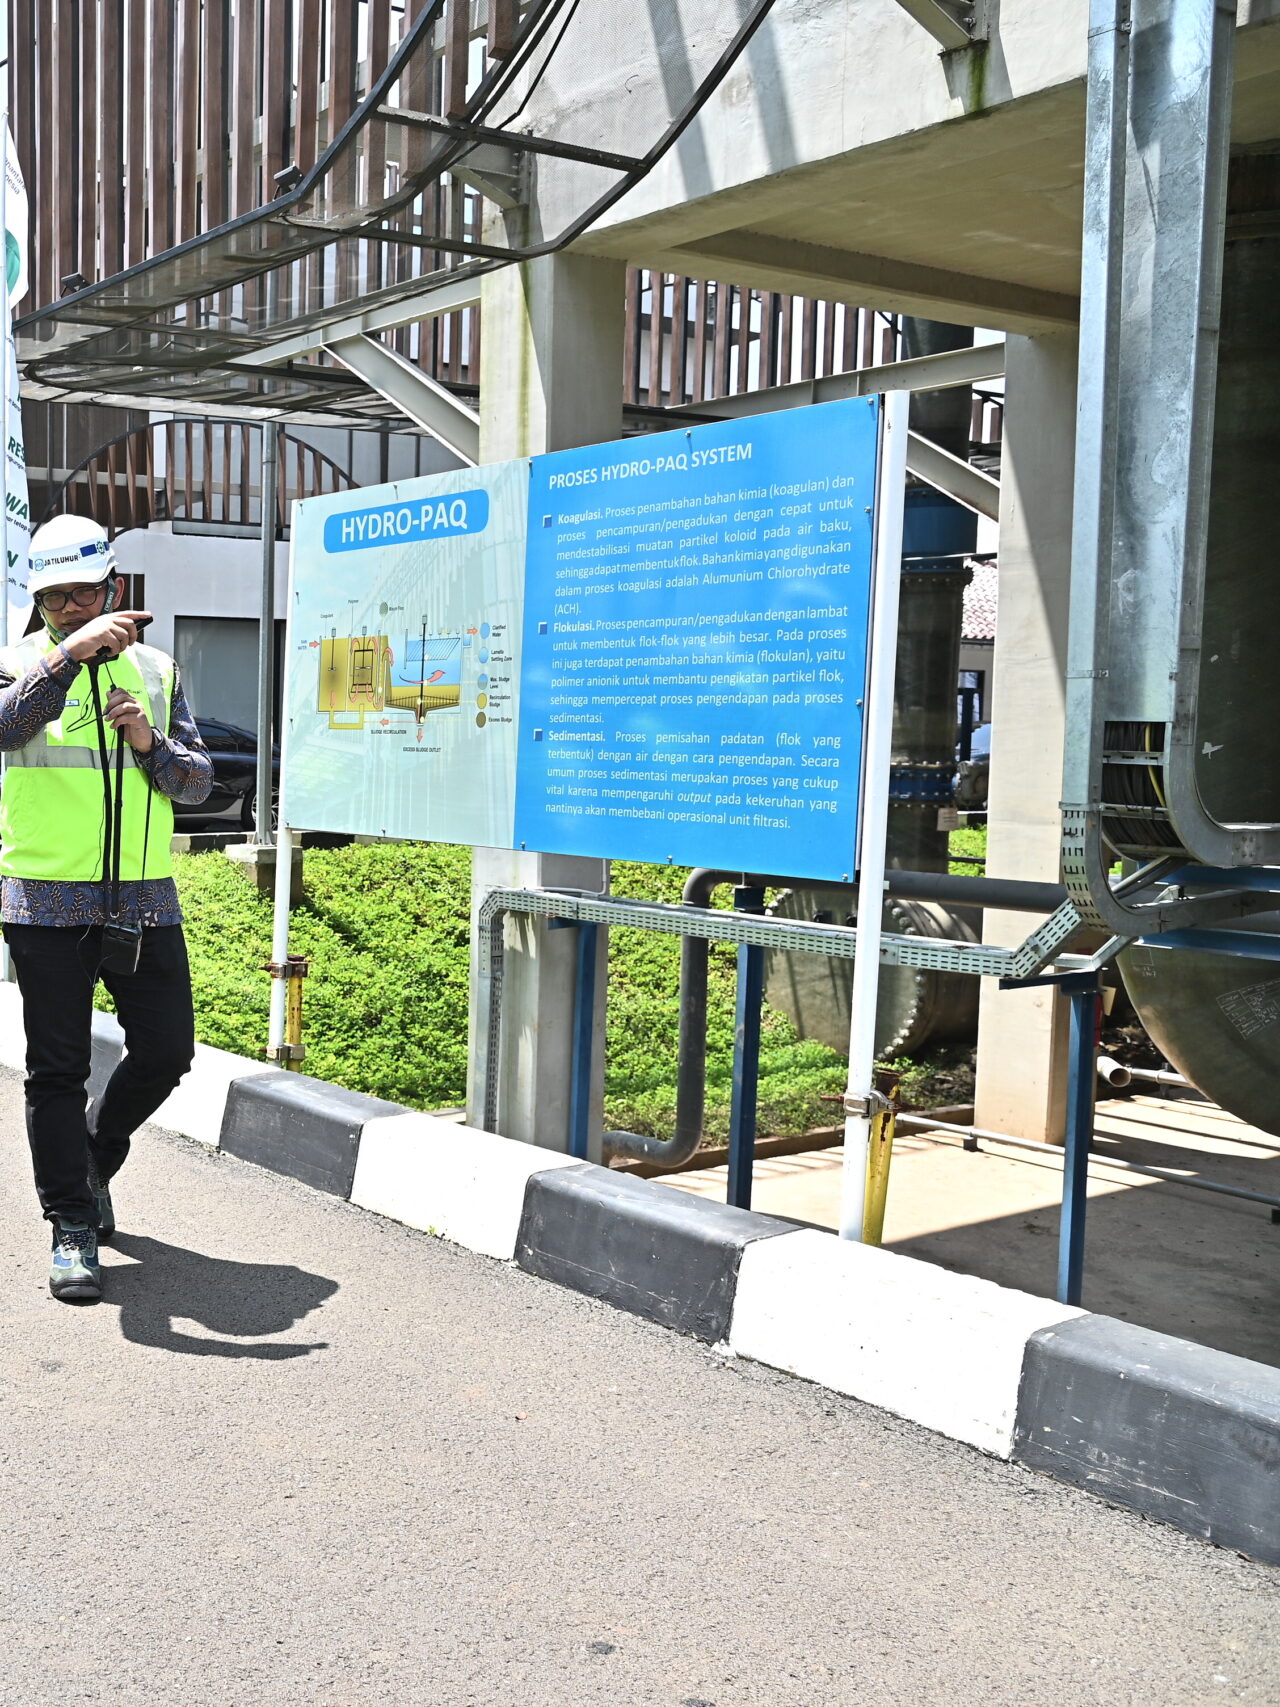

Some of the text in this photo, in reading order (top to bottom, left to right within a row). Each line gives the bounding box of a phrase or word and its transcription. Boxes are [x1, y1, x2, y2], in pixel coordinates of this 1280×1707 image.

[548, 442, 753, 490] PROSES HYDRO-PAQ SYSTEM
[558, 475, 854, 525] Koagulasi. Proses penambahan bahan kimia (koagulan) dan
[341, 498, 468, 544] HYDRO-PAQ
[557, 496, 854, 545] proses pencampuran/pengadukan dengan cepat untuk
[556, 519, 852, 560] mendestabilisasi muatan partikel koloid pada air baku,
[555, 541, 851, 579] sehingga dapat membentuk flok. Bahan kimia yang digunakan
[555, 563, 851, 597] dalam proses koagulasi adalah Alumunium Chlorohydrate
[553, 605, 849, 633] Flokulasi. Proses pencampuran/pengadukan dengan lambat
[554, 602, 581, 617] (ACH).
[553, 628, 848, 651] untuk membentuk flok-flok yang lebih besar. Pada proses
[552, 648, 846, 671] ini juga terdapat penambahan bahan kimia (flokulan), yaitu
[551, 669, 844, 689] polimer anionik untuk membantu pengikatan partikel flok,
[549, 691, 844, 707] sehingga mempercepat proses pengendapan pada proses
[549, 712, 604, 723] sedimentasi.
[548, 730, 842, 749] Sedimentasi. Proses pemisahan padatan (flok yang
[547, 748, 840, 768] terbentuk) dengan air dengan cara pengendapan. Secara
[547, 769, 839, 792] umum proses sedimentasi merupakan proses yang cukup
[546, 784, 838, 814] vital karena mempengaruhi output pada kekeruhan yang
[545, 804, 791, 828] nantinya akan membebani operasional unit filtrasi.
